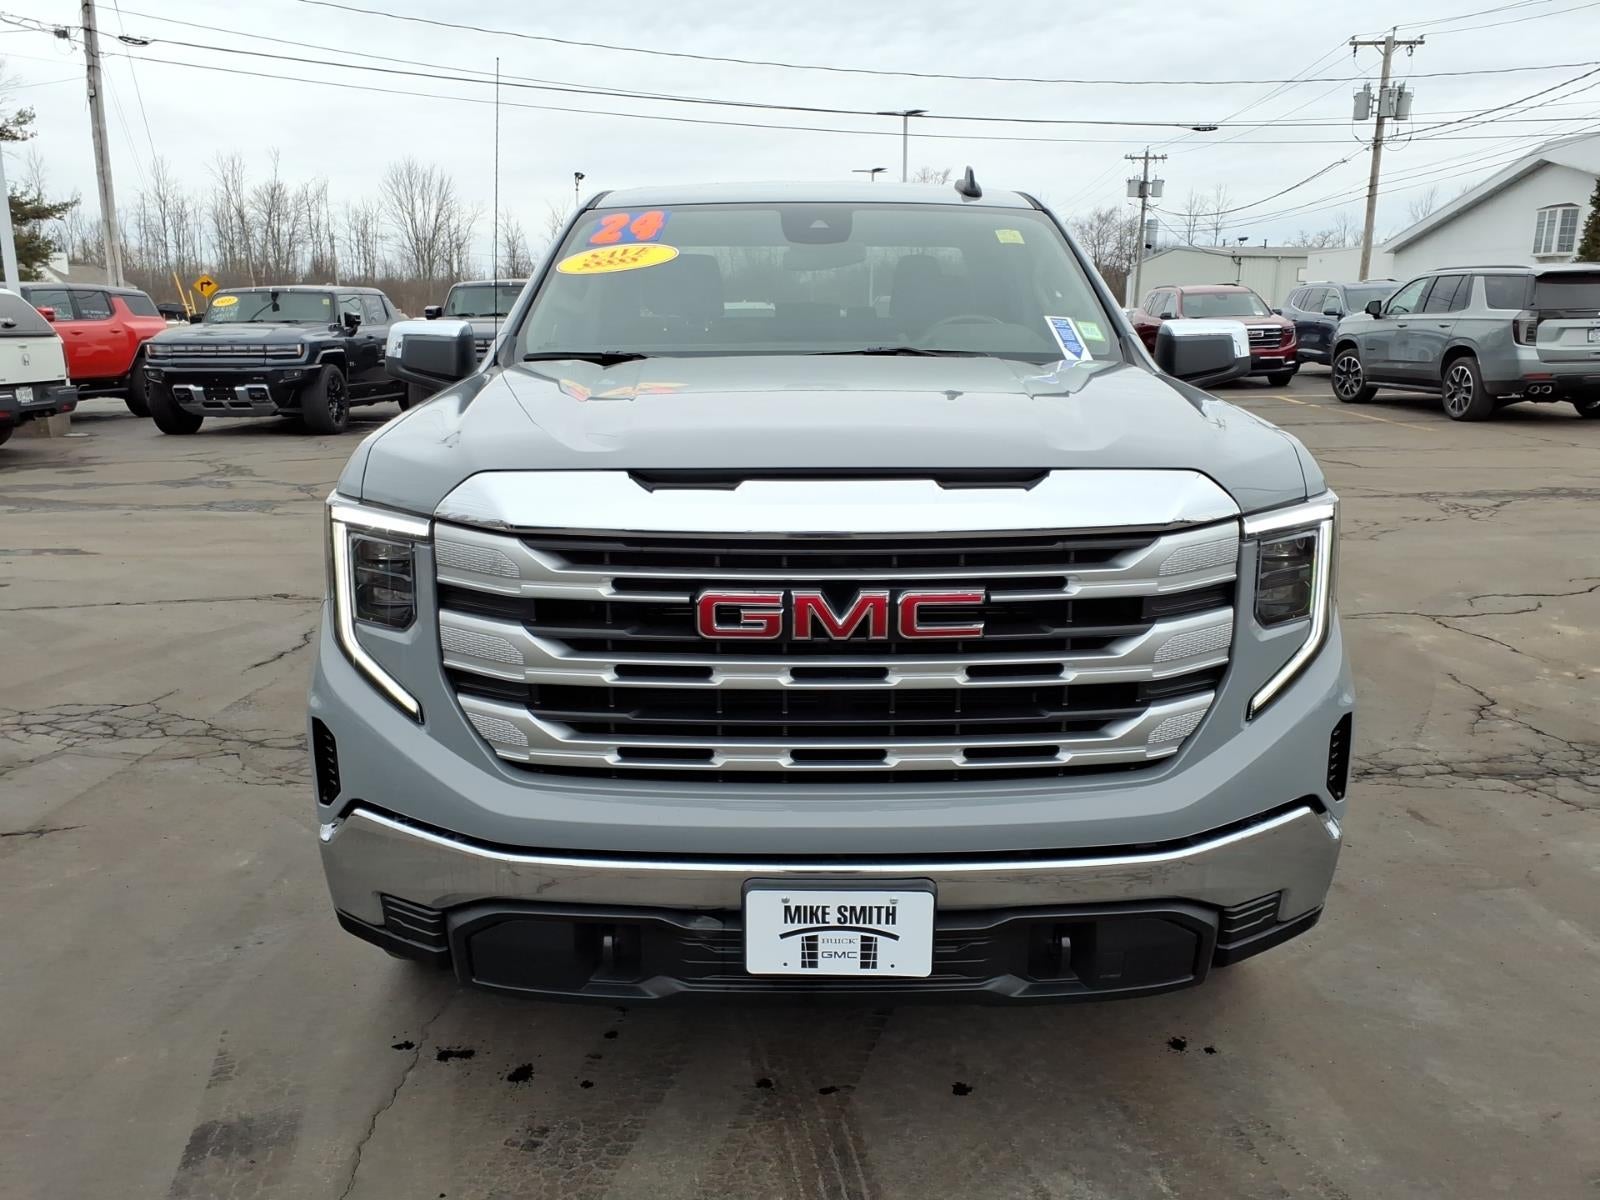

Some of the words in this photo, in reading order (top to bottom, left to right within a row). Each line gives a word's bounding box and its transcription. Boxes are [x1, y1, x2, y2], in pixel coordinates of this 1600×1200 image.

[590, 210, 665, 244] 24
[696, 588, 986, 641] GMC
[783, 905, 831, 925] MIKE
[836, 905, 897, 926] SMITH
[821, 937, 857, 945] BUICK
[820, 950, 858, 960] GMC
